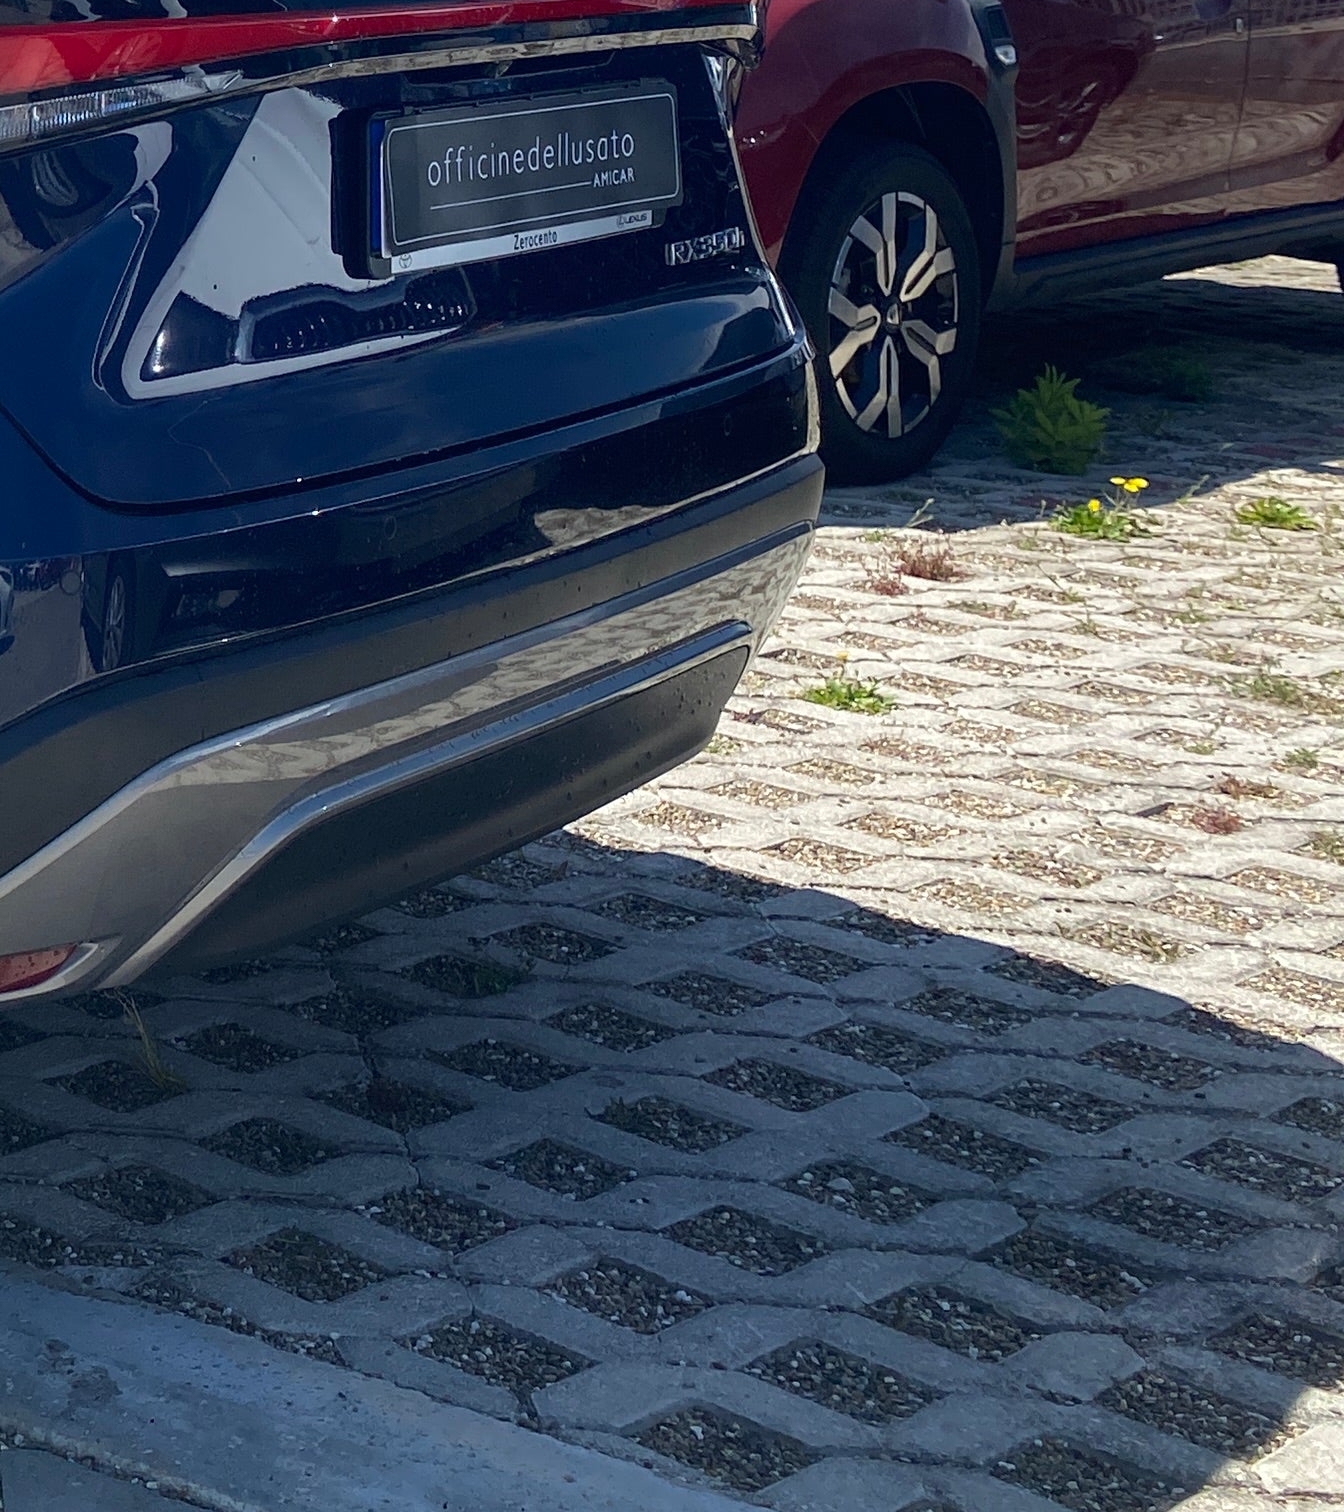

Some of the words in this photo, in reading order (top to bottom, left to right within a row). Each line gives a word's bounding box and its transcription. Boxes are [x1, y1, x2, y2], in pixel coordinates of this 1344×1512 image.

[427, 129, 636, 187] officinedellusato
[592, 166, 636, 189] AMICAR
[513, 229, 559, 251] Zerocento
